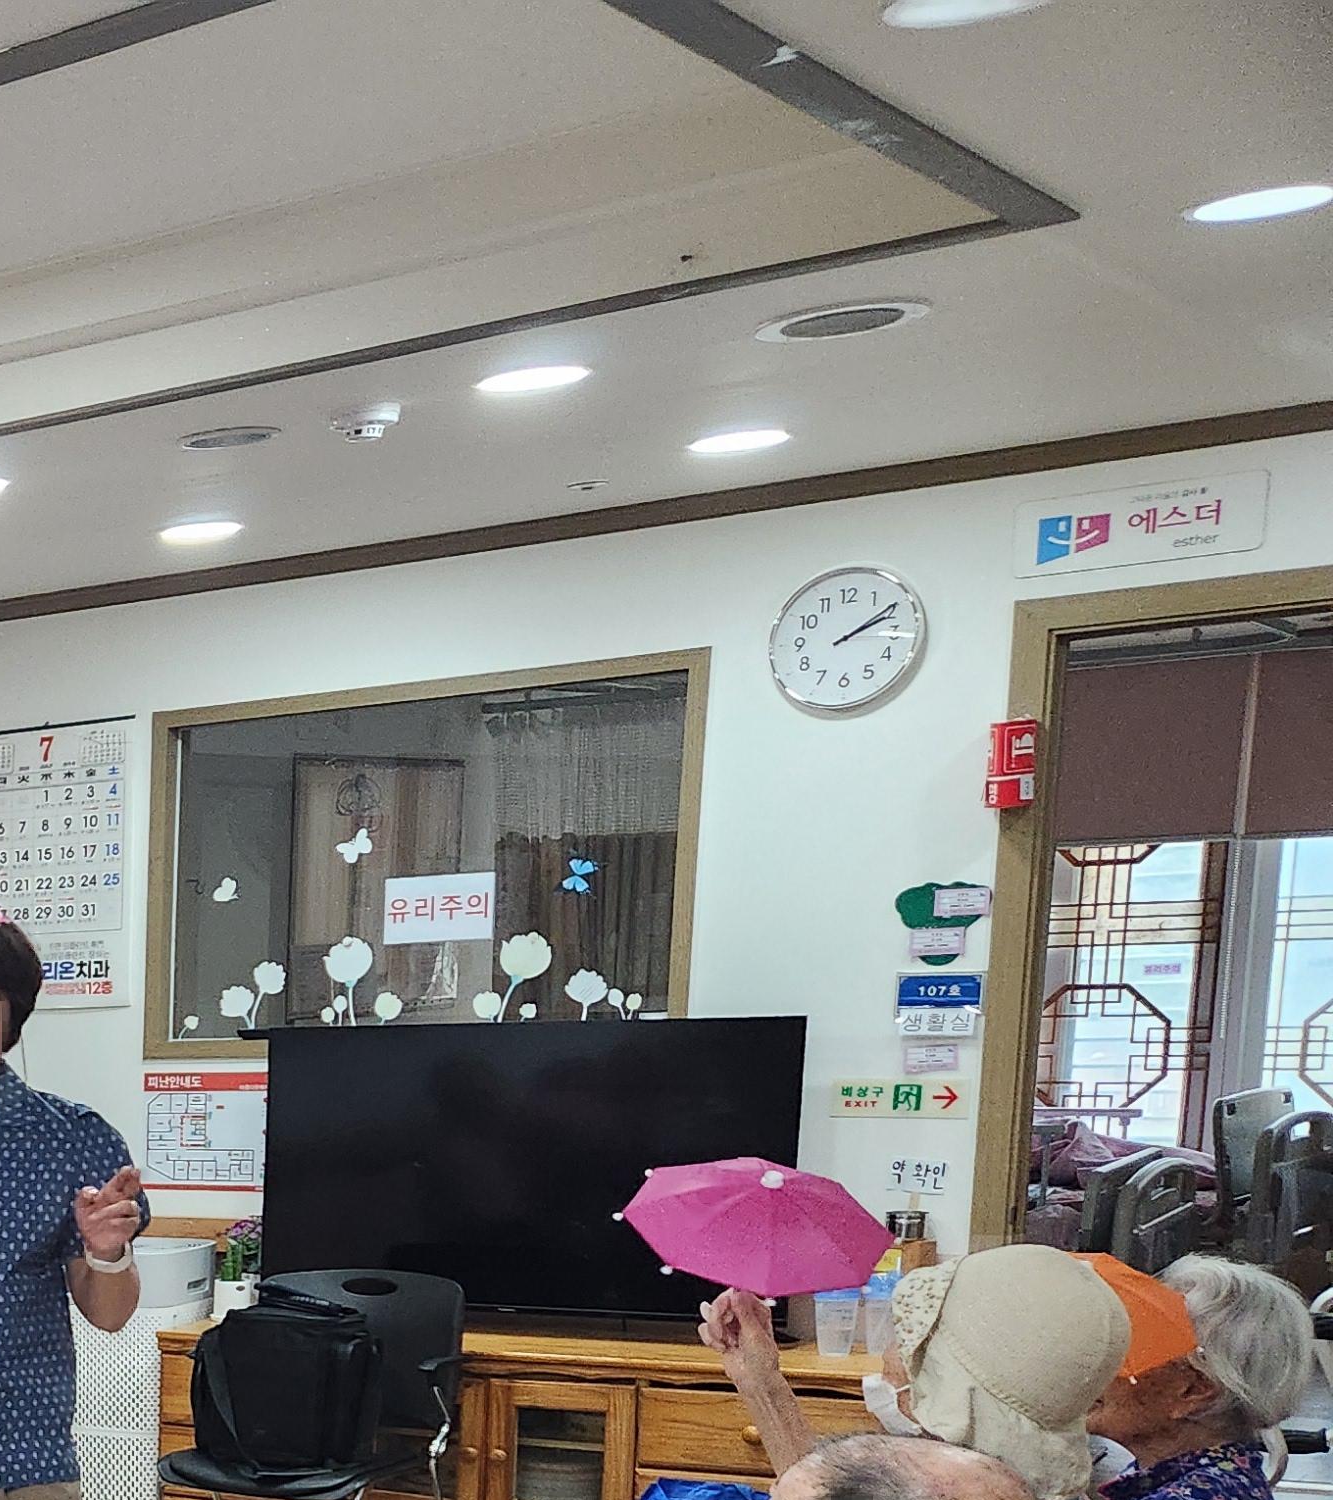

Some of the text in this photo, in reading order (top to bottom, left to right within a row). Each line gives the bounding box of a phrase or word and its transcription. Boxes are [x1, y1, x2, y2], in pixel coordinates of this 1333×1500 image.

[1128, 499, 1221, 533] 에스더
[1173, 534, 1219, 547] esther
[840, 587, 858, 604] 12
[871, 591, 877, 606] 1
[819, 597, 831, 613] 11
[800, 614, 818, 630] 10
[794, 637, 805, 652] 9
[880, 646, 892, 661] 4
[799, 656, 810, 671] 8
[863, 664, 874, 679] 5
[816, 670, 827, 685] 7
[838, 672, 850, 688] 6
[40, 736, 54, 762] 7
[109, 766, 120, 775] 土
[44, 783, 117, 802] 1 2 3 4
[19, 821, 26, 833] 7
[42, 819, 49, 831] 8
[64, 817, 72, 830] 9
[83, 815, 98, 828] 10
[107, 813, 120, 826] 11
[15, 850, 29, 862] 14
[38, 848, 52, 860] 15
[60, 846, 74, 859] 16
[83, 844, 97, 857] 17
[105, 843, 120, 856] 18
[15, 879, 29, 891] 21
[36, 877, 52, 890] 22
[58, 876, 74, 888] 23
[81, 874, 97, 887] 24
[104, 873, 120, 885] 25
[14, 908, 29, 920] 28
[36, 906, 52, 919] 29
[58, 905, 74, 918] 30
[82, 903, 96, 916] 31
[387, 891, 489, 924] 유리주의
[918, 984, 962, 996] 107호
[902, 1013, 971, 1032] 생활실
[147, 1075, 202, 1089] 피난안내도
[841, 1086, 883, 1098] 비상구
[892, 1160, 946, 1190] 약 확인
